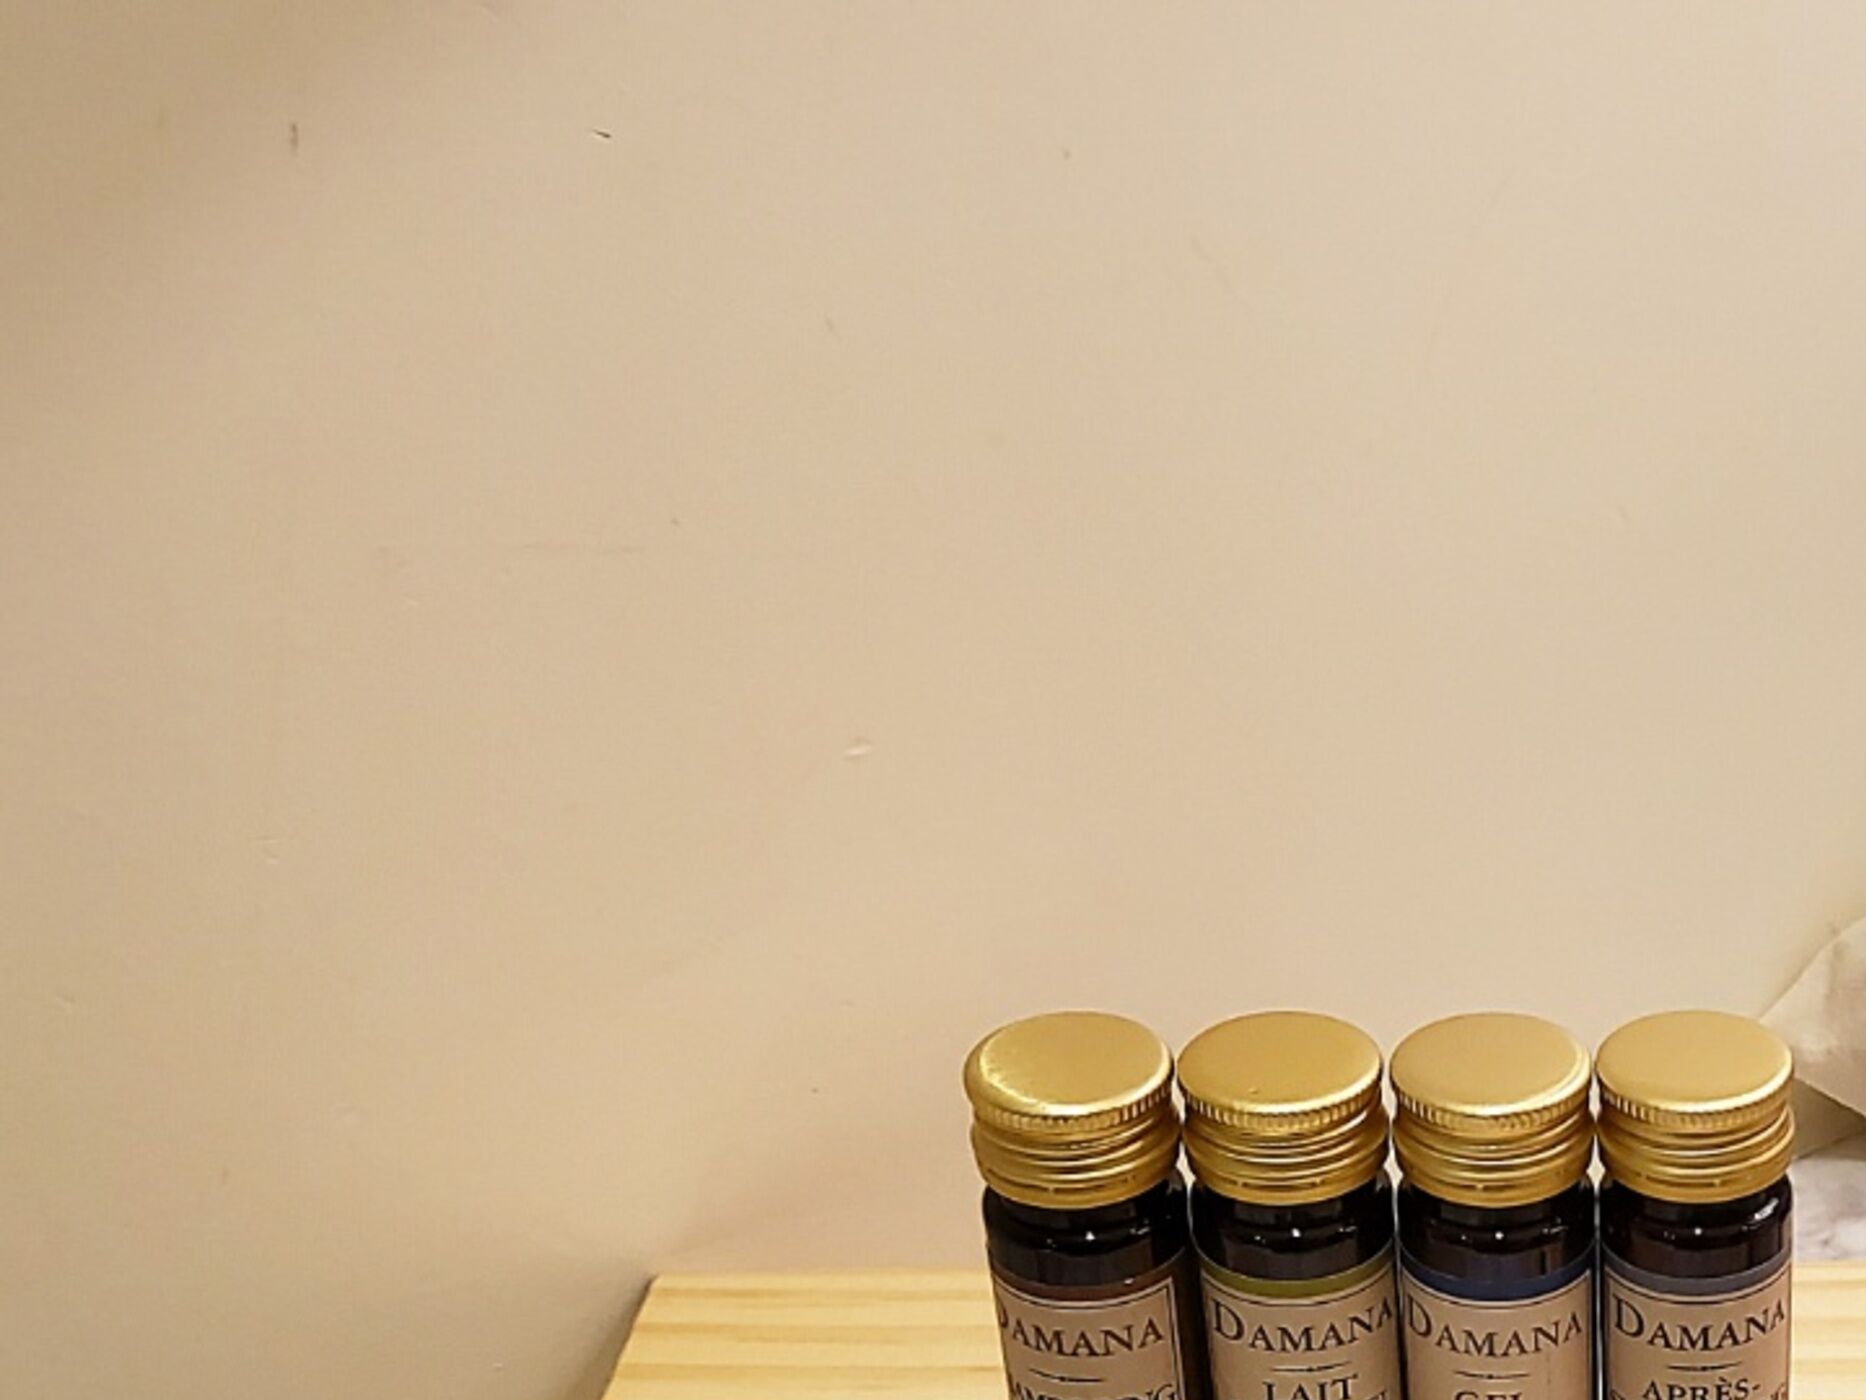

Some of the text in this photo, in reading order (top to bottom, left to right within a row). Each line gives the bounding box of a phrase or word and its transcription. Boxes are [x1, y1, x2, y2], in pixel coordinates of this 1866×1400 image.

[1212, 1300, 1393, 1352] DAMANA
[1407, 1293, 1583, 1357] DAMANA
[1613, 1294, 1785, 1351] DAMANA
